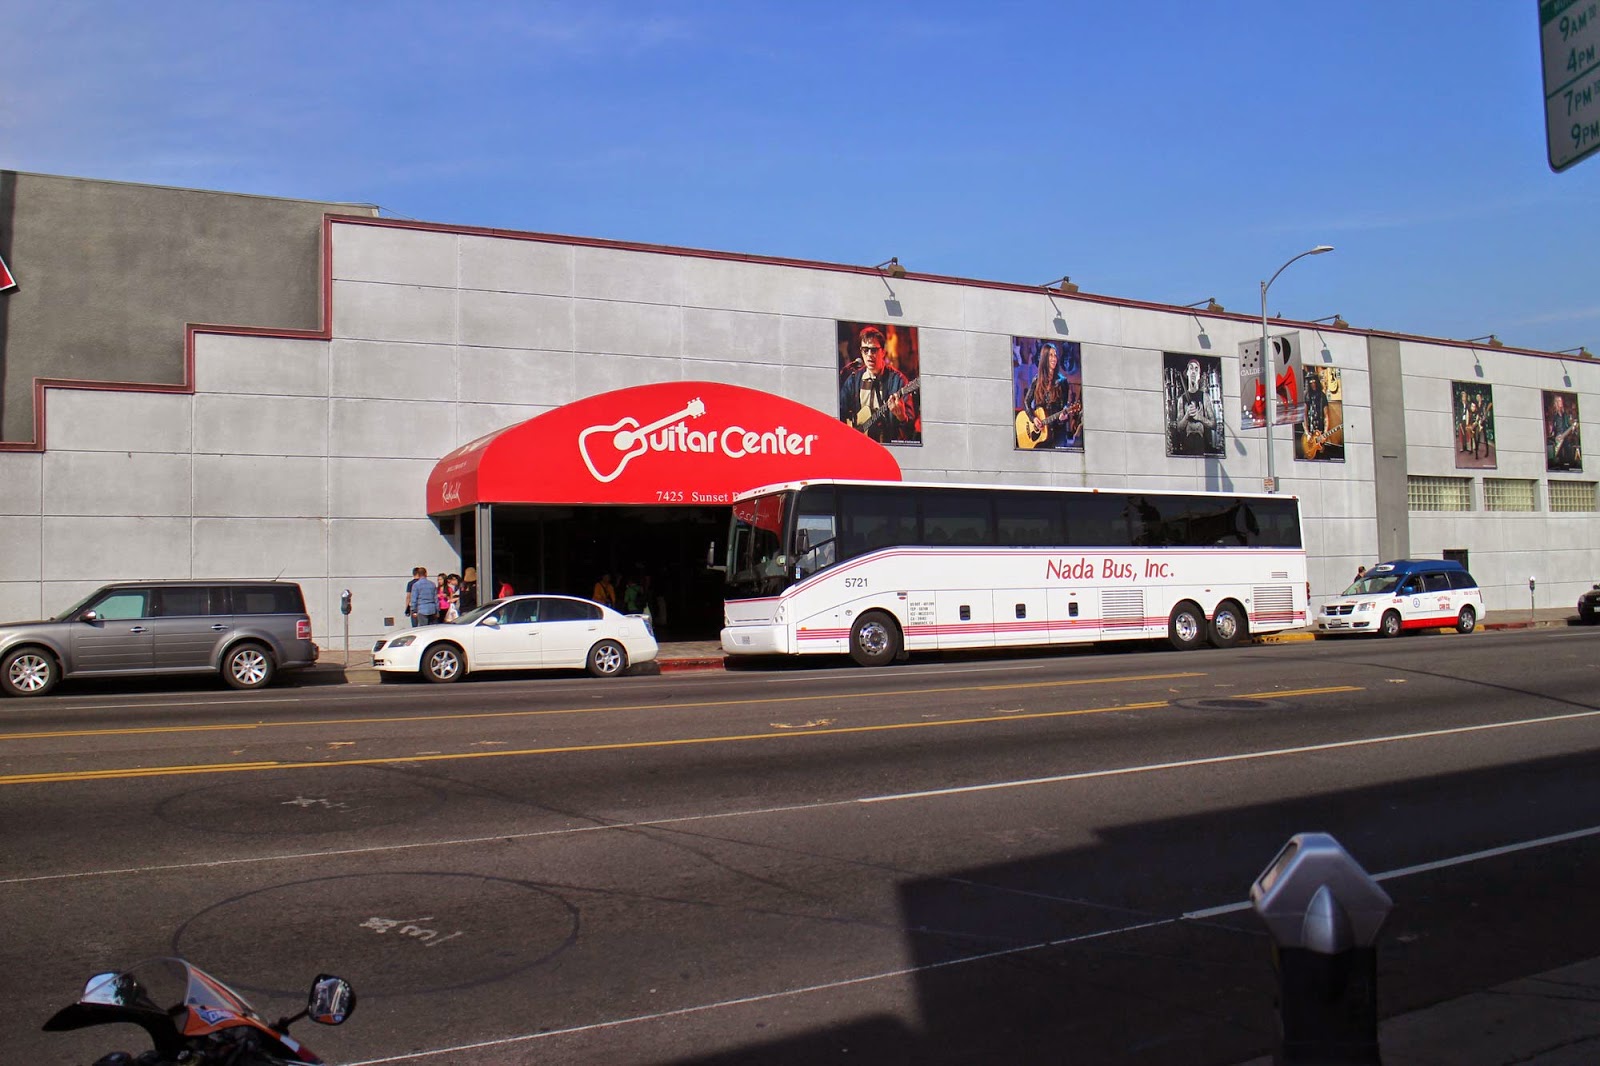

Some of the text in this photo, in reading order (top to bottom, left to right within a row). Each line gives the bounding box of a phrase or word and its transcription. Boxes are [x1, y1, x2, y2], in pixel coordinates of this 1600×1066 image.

[1559, 12, 1587, 42] 9AM
[1567, 45, 1595, 72] 4PM
[1564, 87, 1592, 117] 7PM
[1571, 120, 1600, 149] 9PM
[578, 397, 812, 483] Guitar Center
[656, 491, 684, 502] 7425
[691, 492, 729, 502] Sunset
[845, 578, 868, 588] 5721
[1046, 558, 1174, 581] Nada Bus, Inc.
